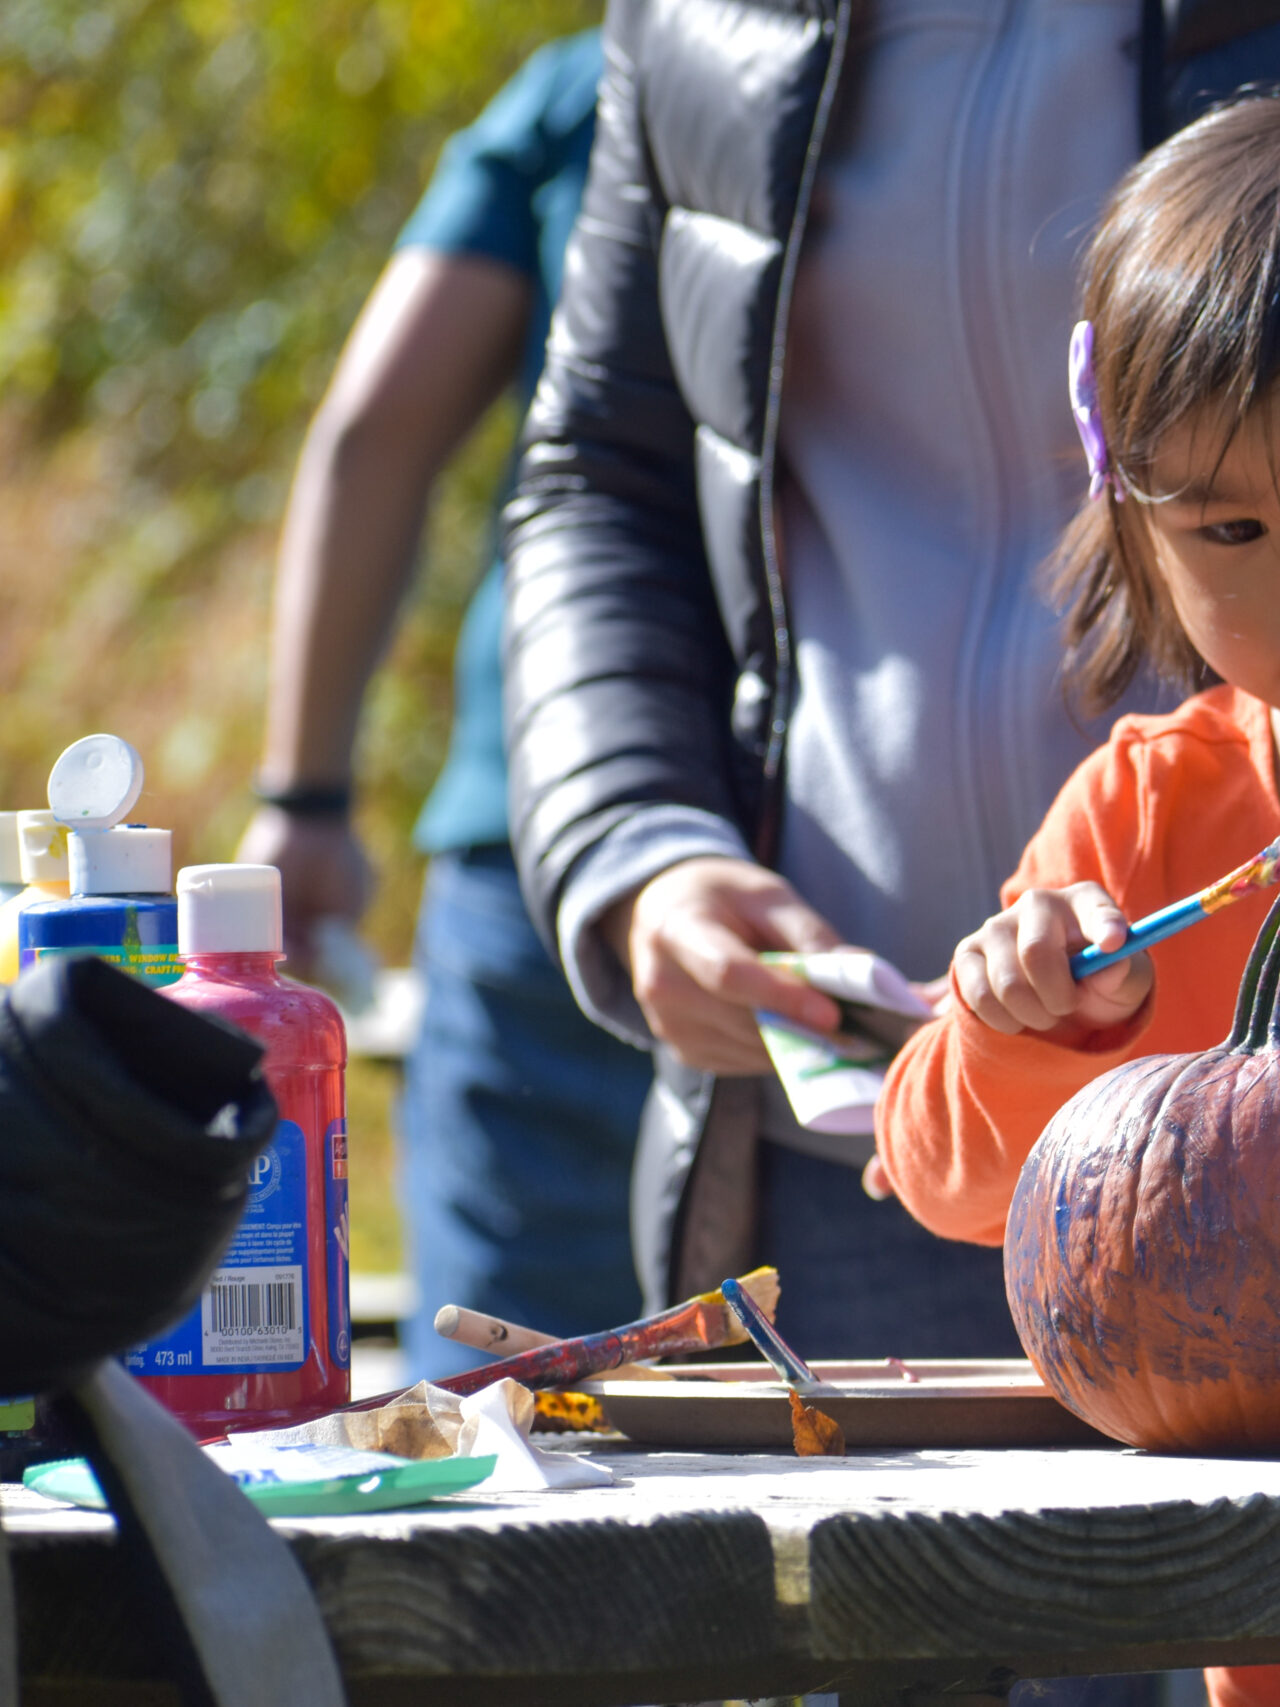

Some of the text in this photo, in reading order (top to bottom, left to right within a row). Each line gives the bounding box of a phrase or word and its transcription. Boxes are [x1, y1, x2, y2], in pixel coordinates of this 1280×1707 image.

[129, 954, 167, 963] WINDOW
[145, 966, 171, 974] CRAFT
[155, 1350, 193, 1367] 473 ml
